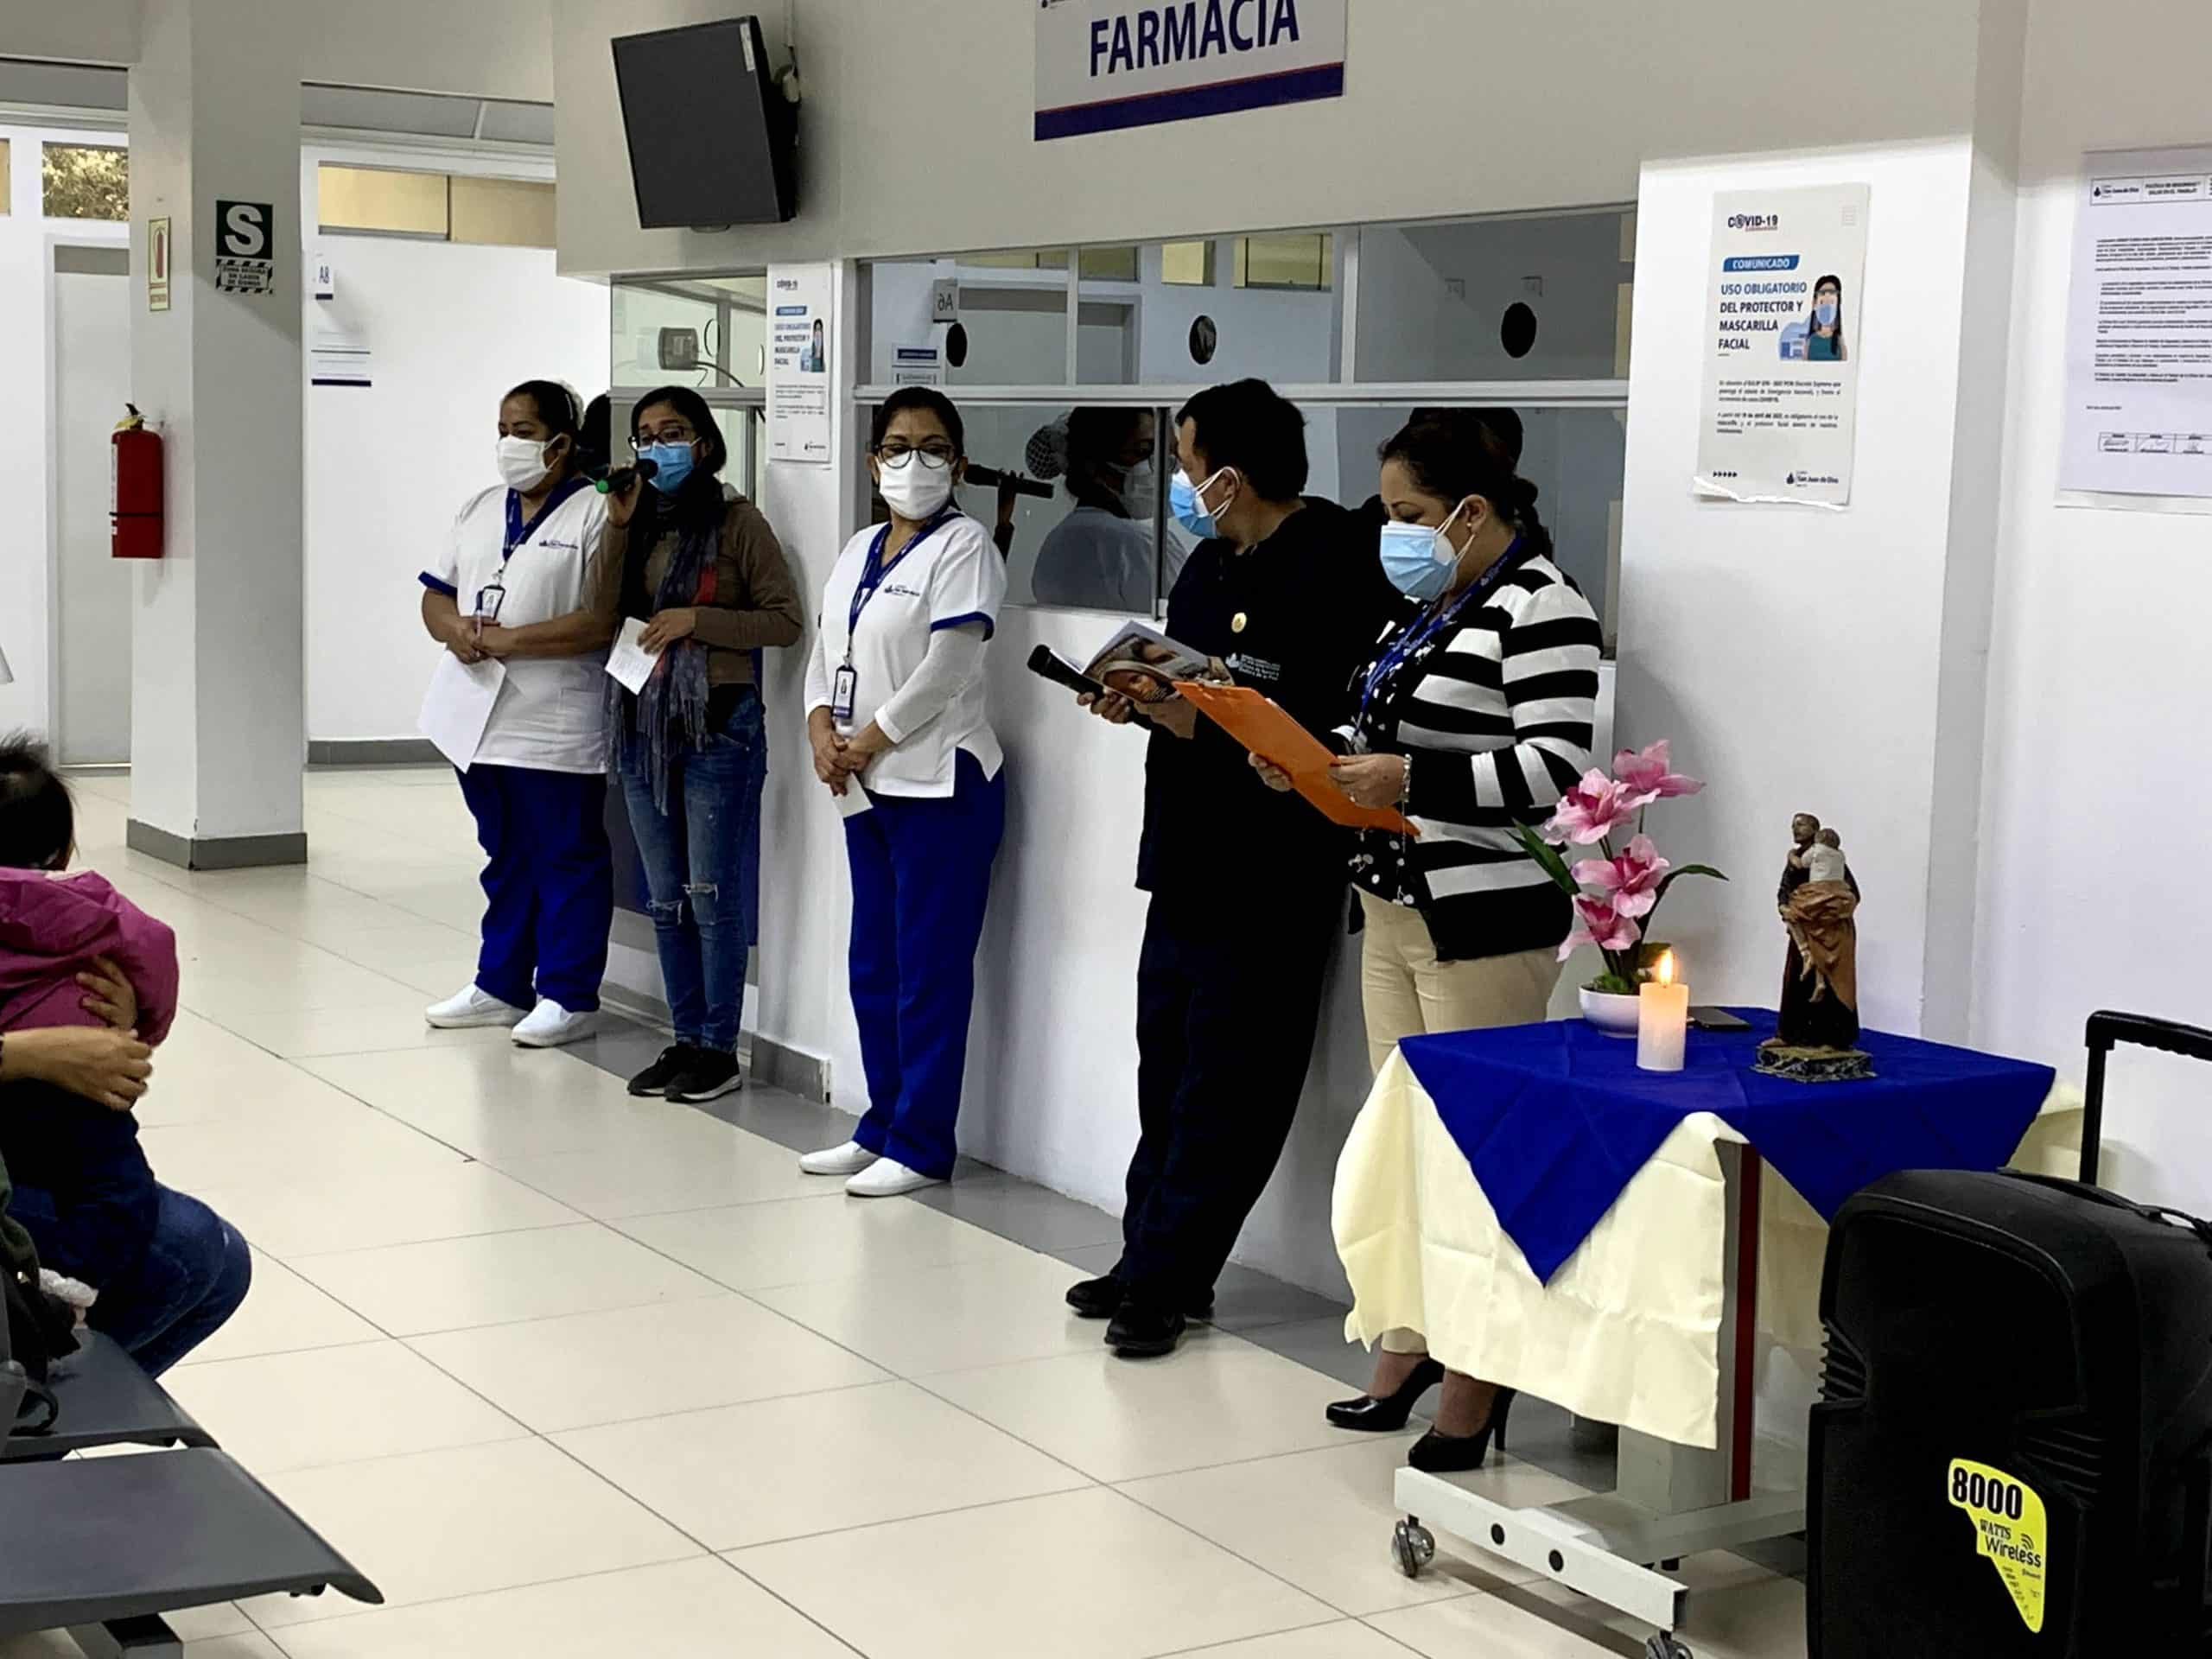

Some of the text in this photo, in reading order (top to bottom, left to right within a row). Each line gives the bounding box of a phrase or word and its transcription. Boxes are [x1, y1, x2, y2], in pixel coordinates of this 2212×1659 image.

[1090, 0, 1300, 77] FARMACIA
[1728, 213, 1778, 228] COVID-19
[225, 205, 264, 255] S
[1732, 257, 1790, 270] COMUNICADO
[1721, 282, 1808, 295] USO OBLIGATORIO
[1719, 301, 1803, 313] DEL PROTECTOR Y
[1719, 320, 1778, 331] MASCARILLA
[1718, 338, 1750, 349] FACIAL
[1952, 1466, 2023, 1521] 8000
[1980, 1519, 2012, 1540] WATTS
[1985, 1534, 2042, 1567] Wireless
